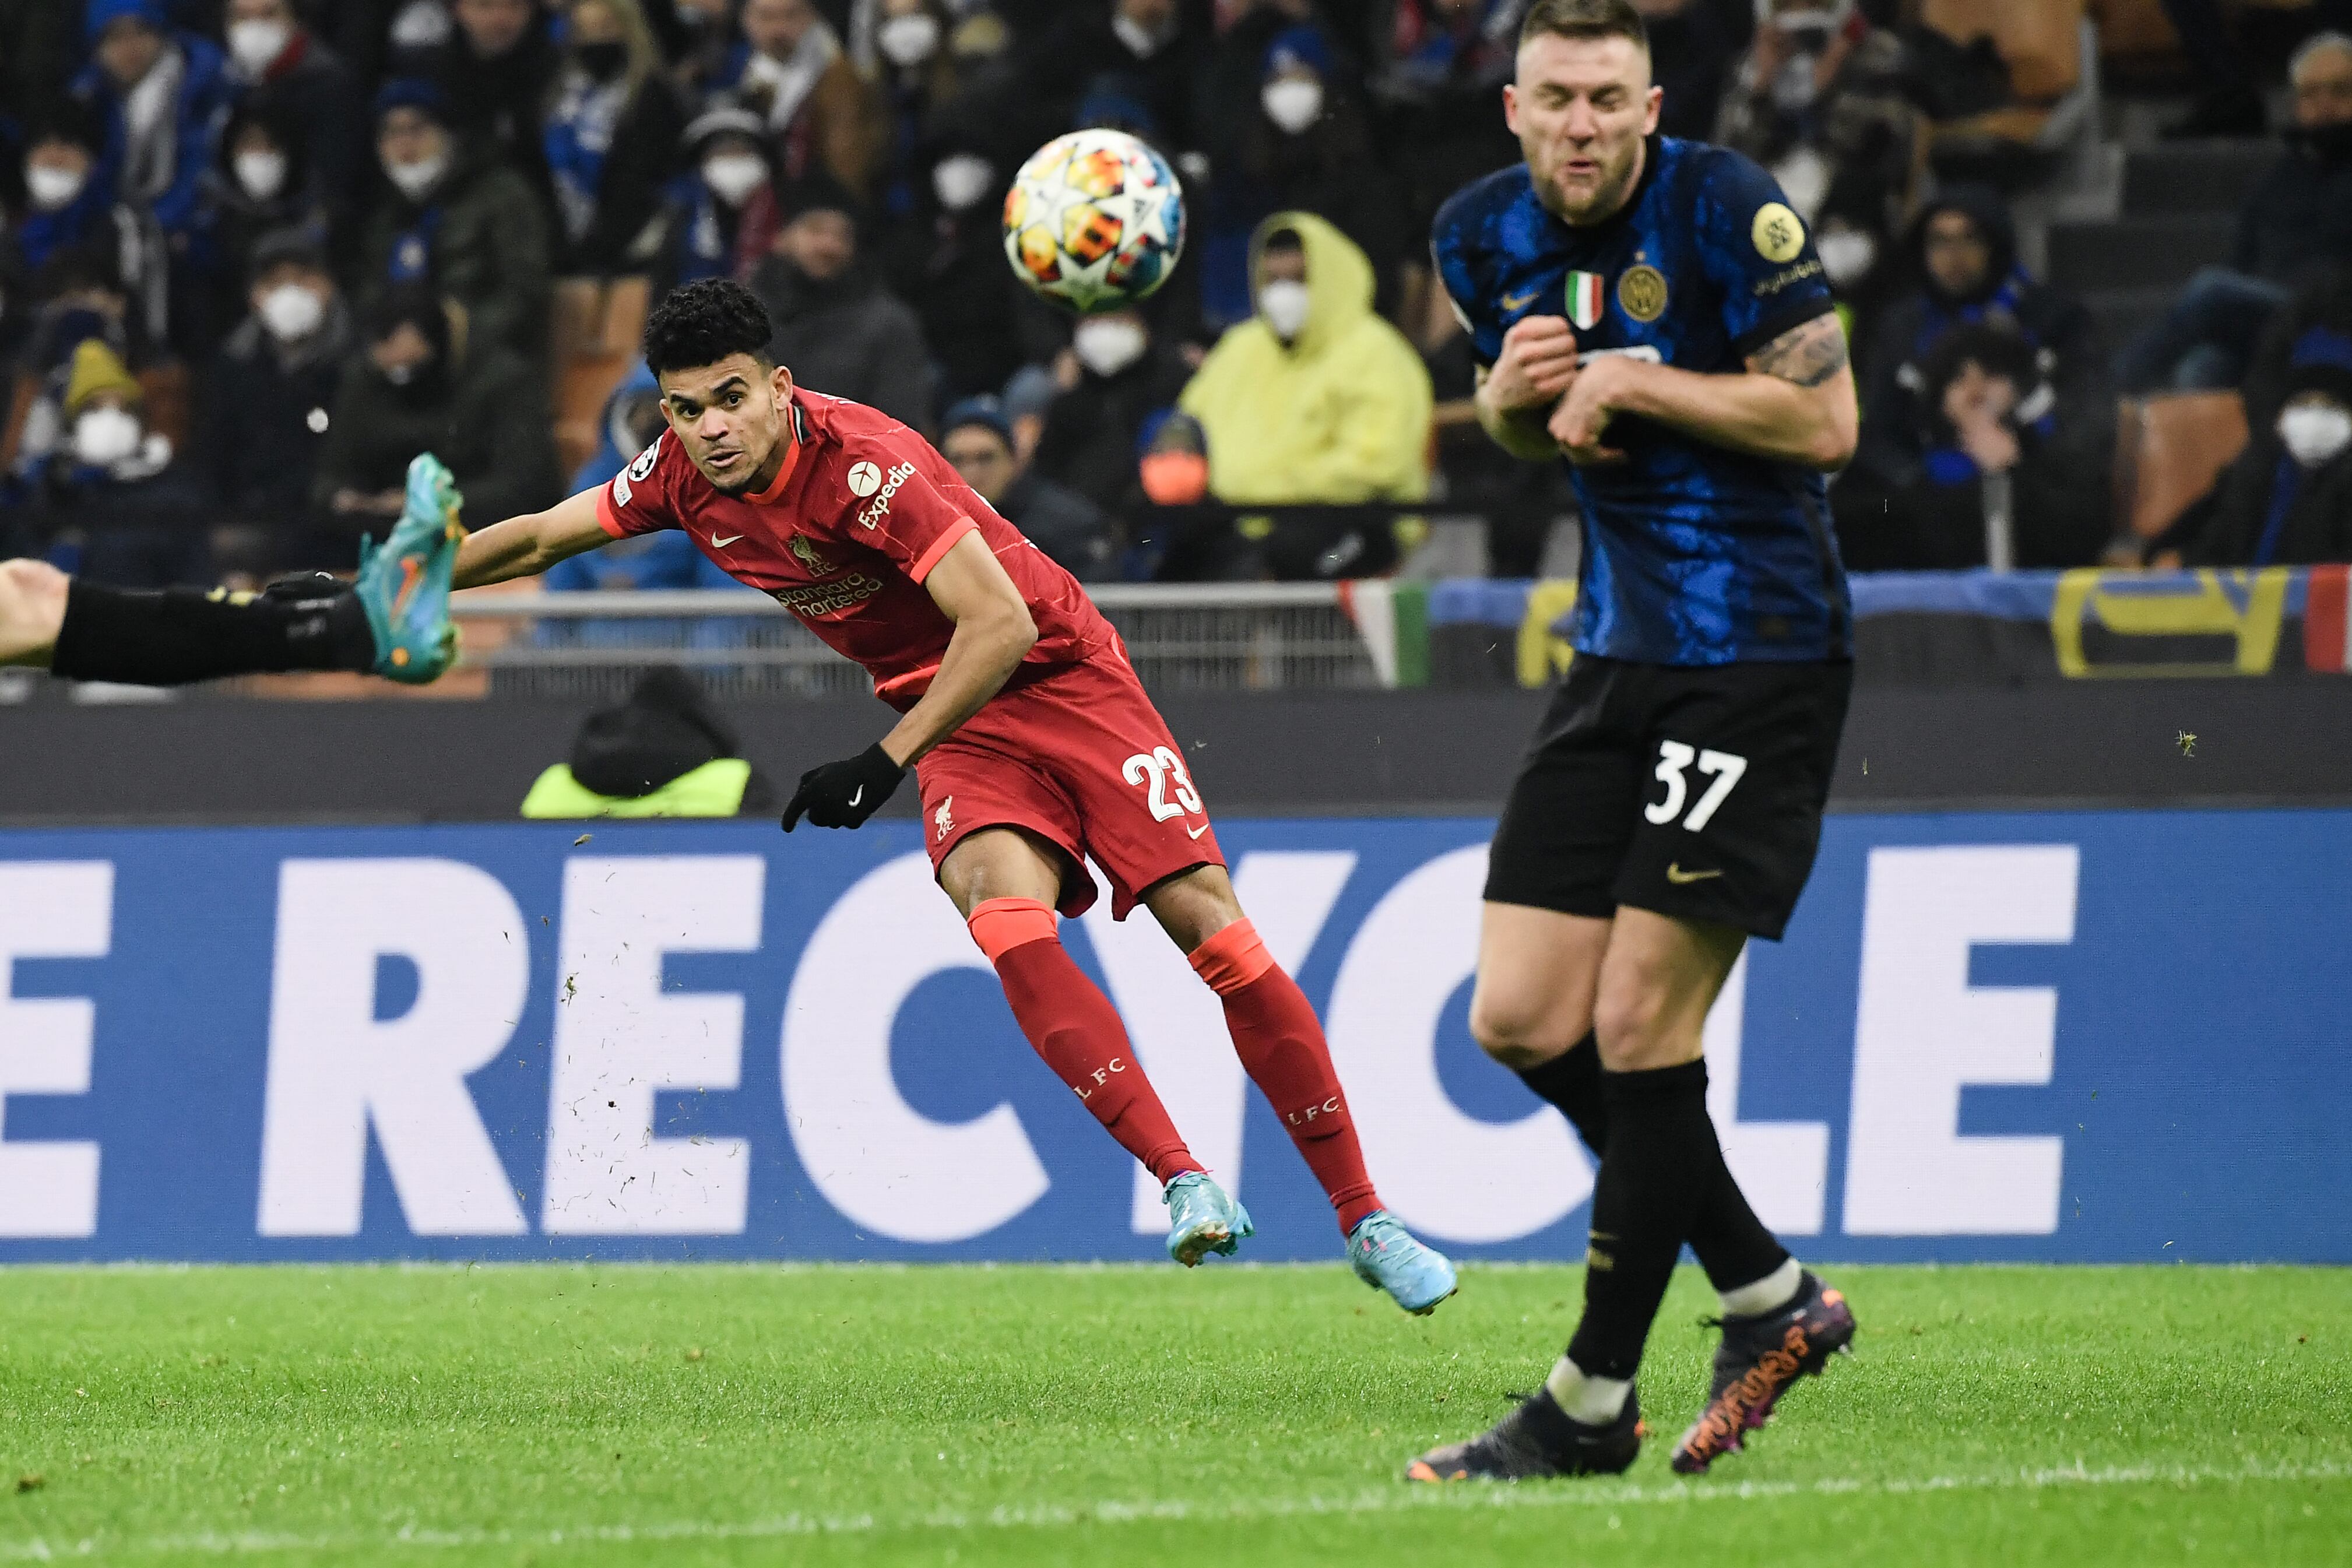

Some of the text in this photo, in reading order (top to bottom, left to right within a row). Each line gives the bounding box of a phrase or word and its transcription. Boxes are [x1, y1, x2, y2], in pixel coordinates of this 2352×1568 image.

[857, 461, 916, 530] Expedia
[1122, 746, 1202, 822] 23
[1644, 739, 1748, 832] 37
[1074, 1058, 1126, 1100] LFC
[1288, 1096, 1343, 1126] LFC
